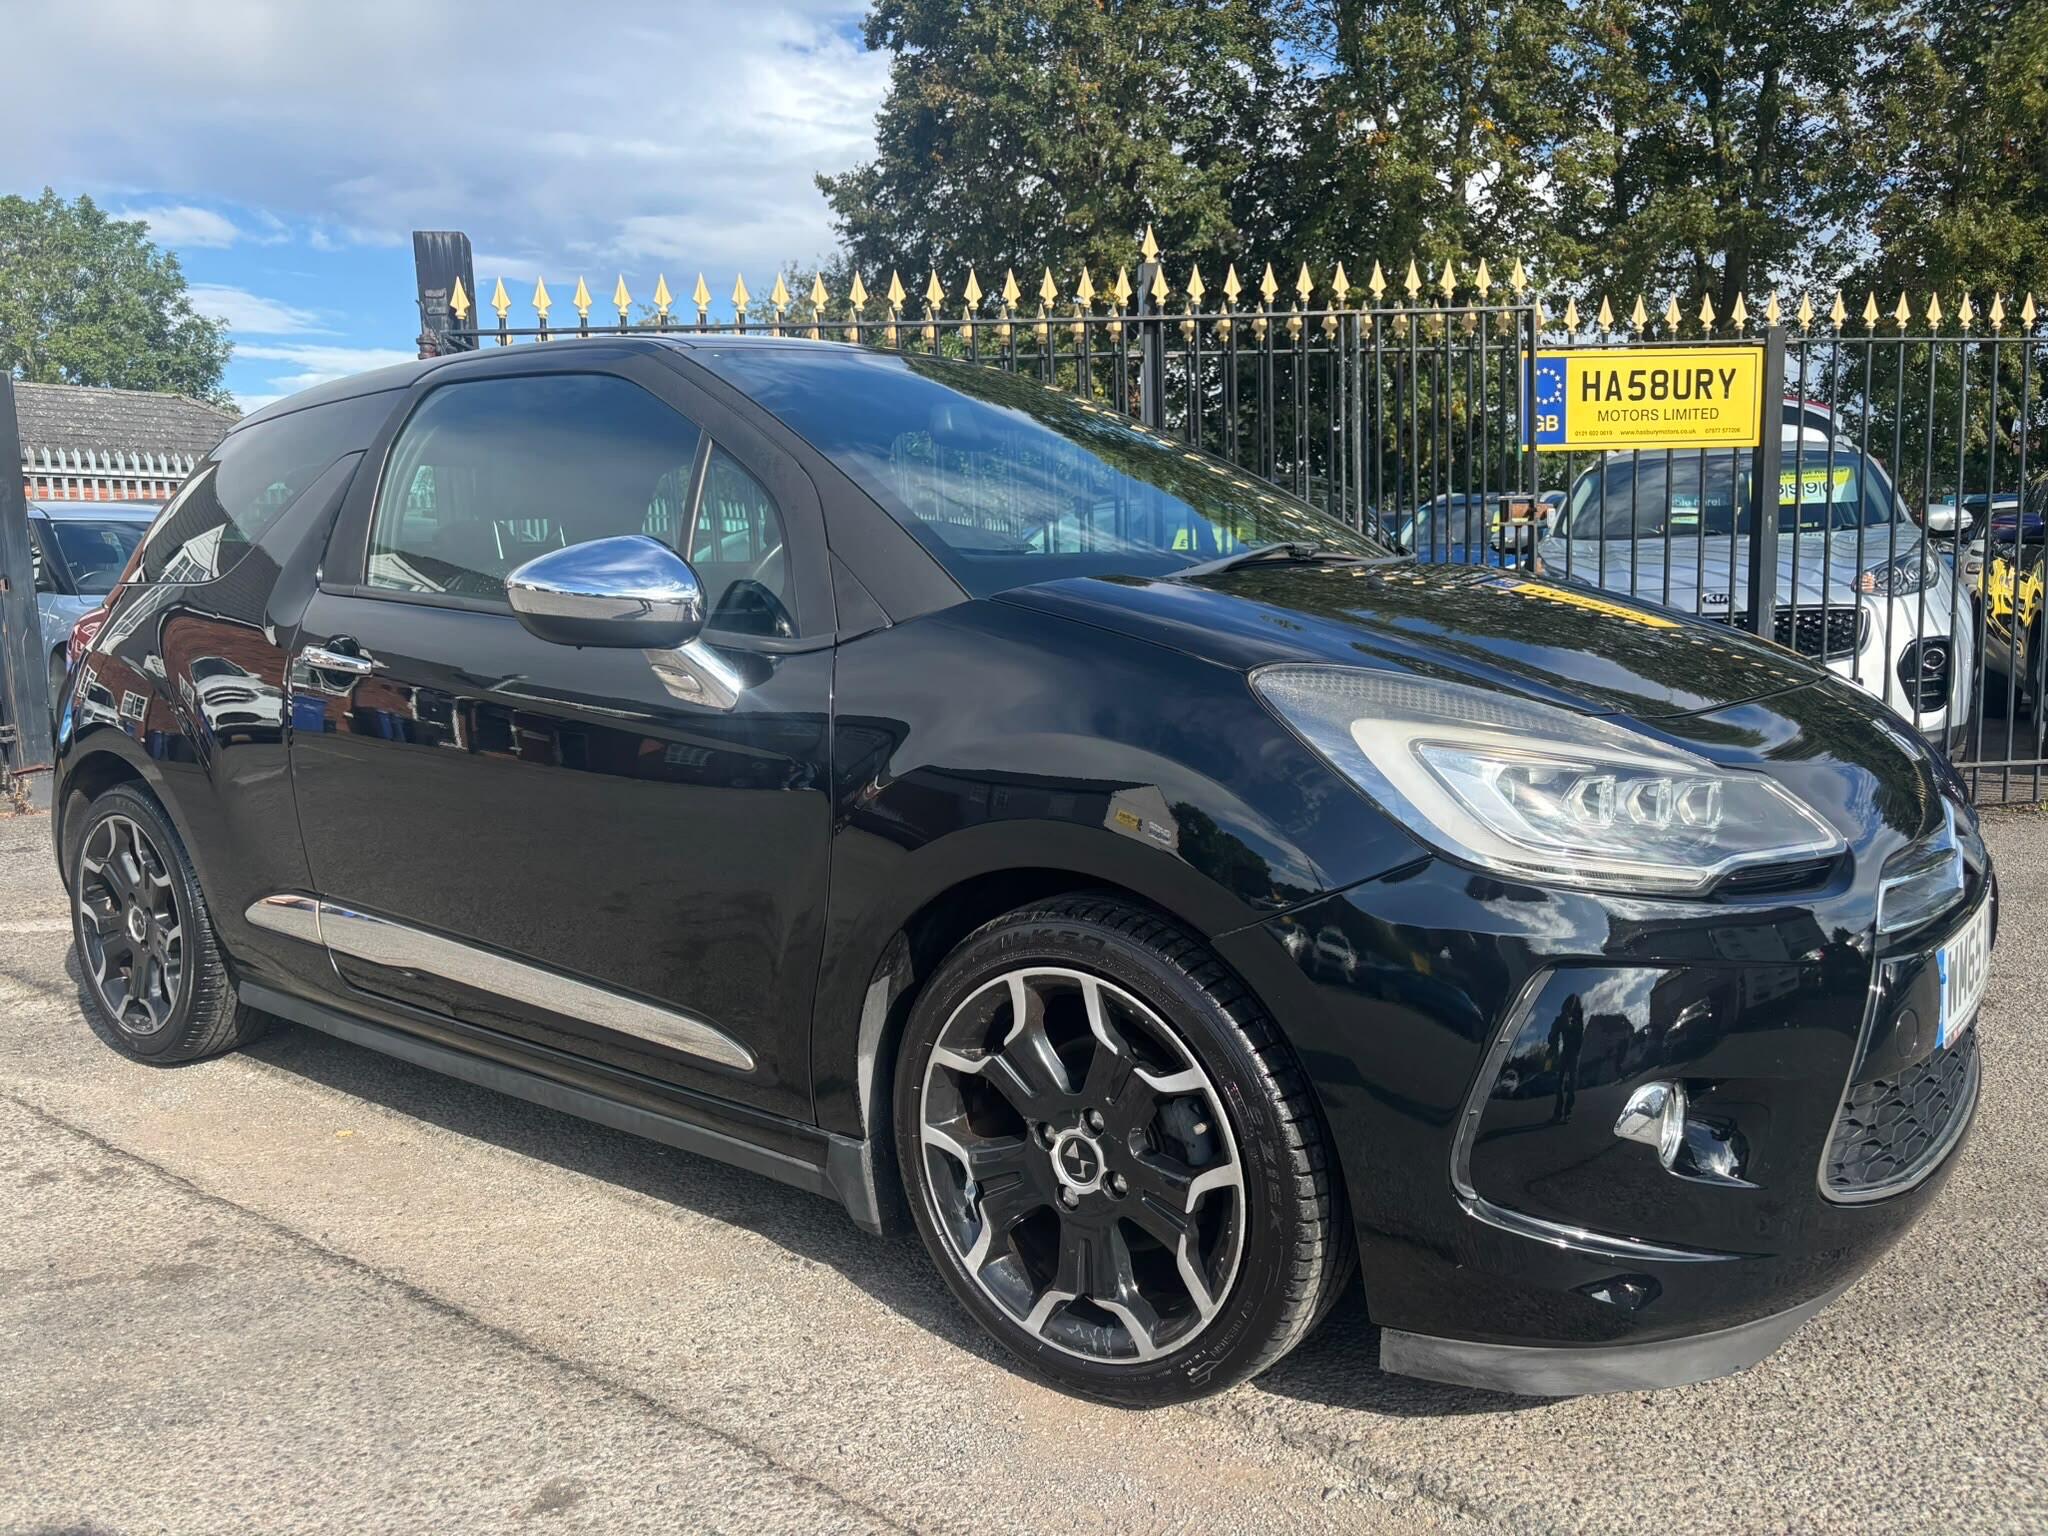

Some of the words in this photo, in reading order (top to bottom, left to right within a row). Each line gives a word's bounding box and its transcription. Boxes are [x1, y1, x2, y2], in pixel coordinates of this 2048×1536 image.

[1582, 368, 1737, 401] HA58URY
[1597, 409, 1659, 422] MOTORS
[1663, 408, 1719, 421] LIMITED
[1536, 415, 1559, 432] GB
[1705, 594, 1730, 604] KIA
